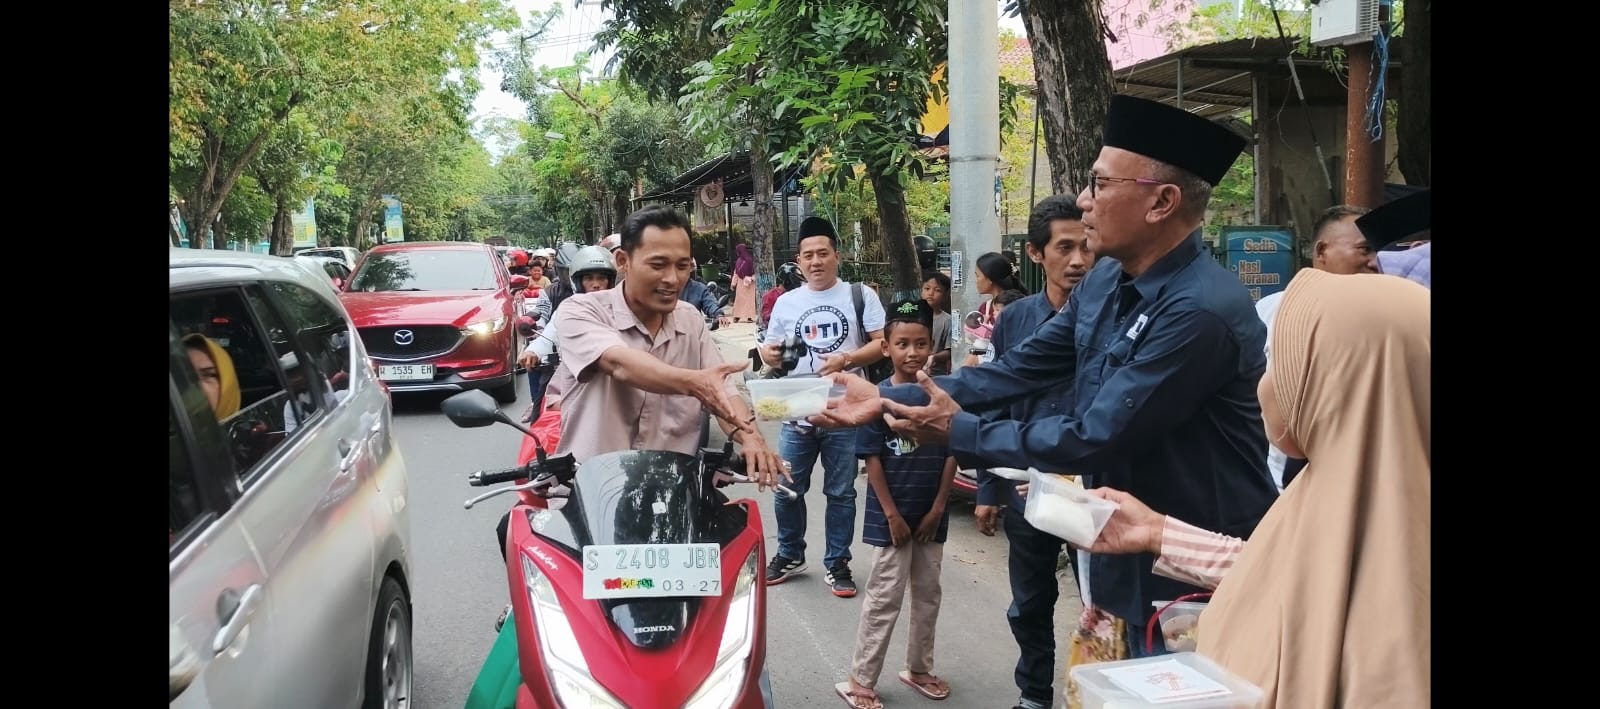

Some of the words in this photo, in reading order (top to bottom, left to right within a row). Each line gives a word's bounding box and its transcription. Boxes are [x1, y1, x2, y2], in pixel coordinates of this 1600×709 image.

[1244, 238, 1278, 254] Sedia
[1239, 260, 1261, 273] Nasi
[391, 365, 413, 375] 1535
[421, 365, 432, 375] EH
[586, 549, 599, 571] S
[615, 547, 670, 570] 2408
[683, 546, 720, 569] JBR
[662, 579, 684, 592] 03
[699, 580, 720, 592] 27
[633, 625, 676, 634] HONDA
